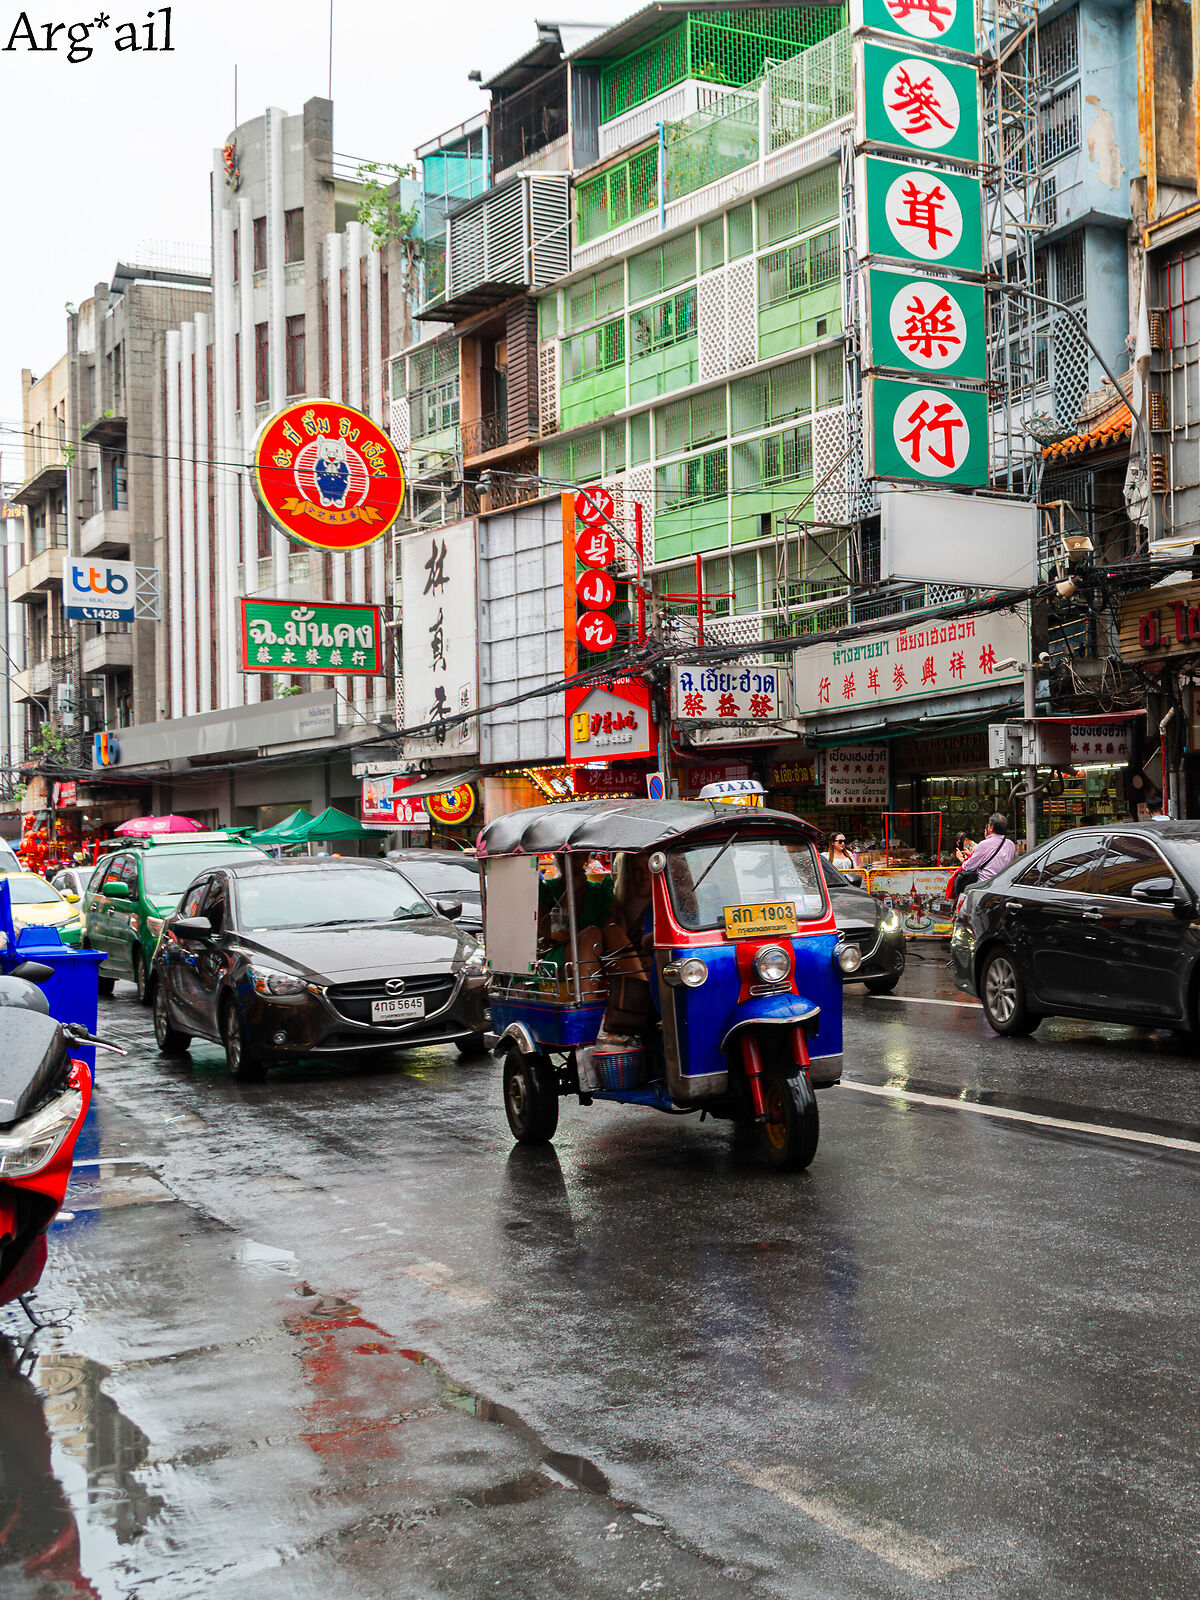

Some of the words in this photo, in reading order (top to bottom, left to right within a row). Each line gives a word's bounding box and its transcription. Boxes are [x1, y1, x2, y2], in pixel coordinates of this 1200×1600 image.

[583, 491, 613, 645] 沙县小吃
[72, 566, 128, 594] ttb
[92, 608, 120, 619] 1428
[249, 606, 373, 648] ฉ.มั่นคง
[681, 691, 775, 718] 蔡益發
[715, 780, 757, 793] TAXI
[731, 908, 753, 923] สก
[760, 905, 793, 921] 1903
[397, 998, 423, 1010] 5645
